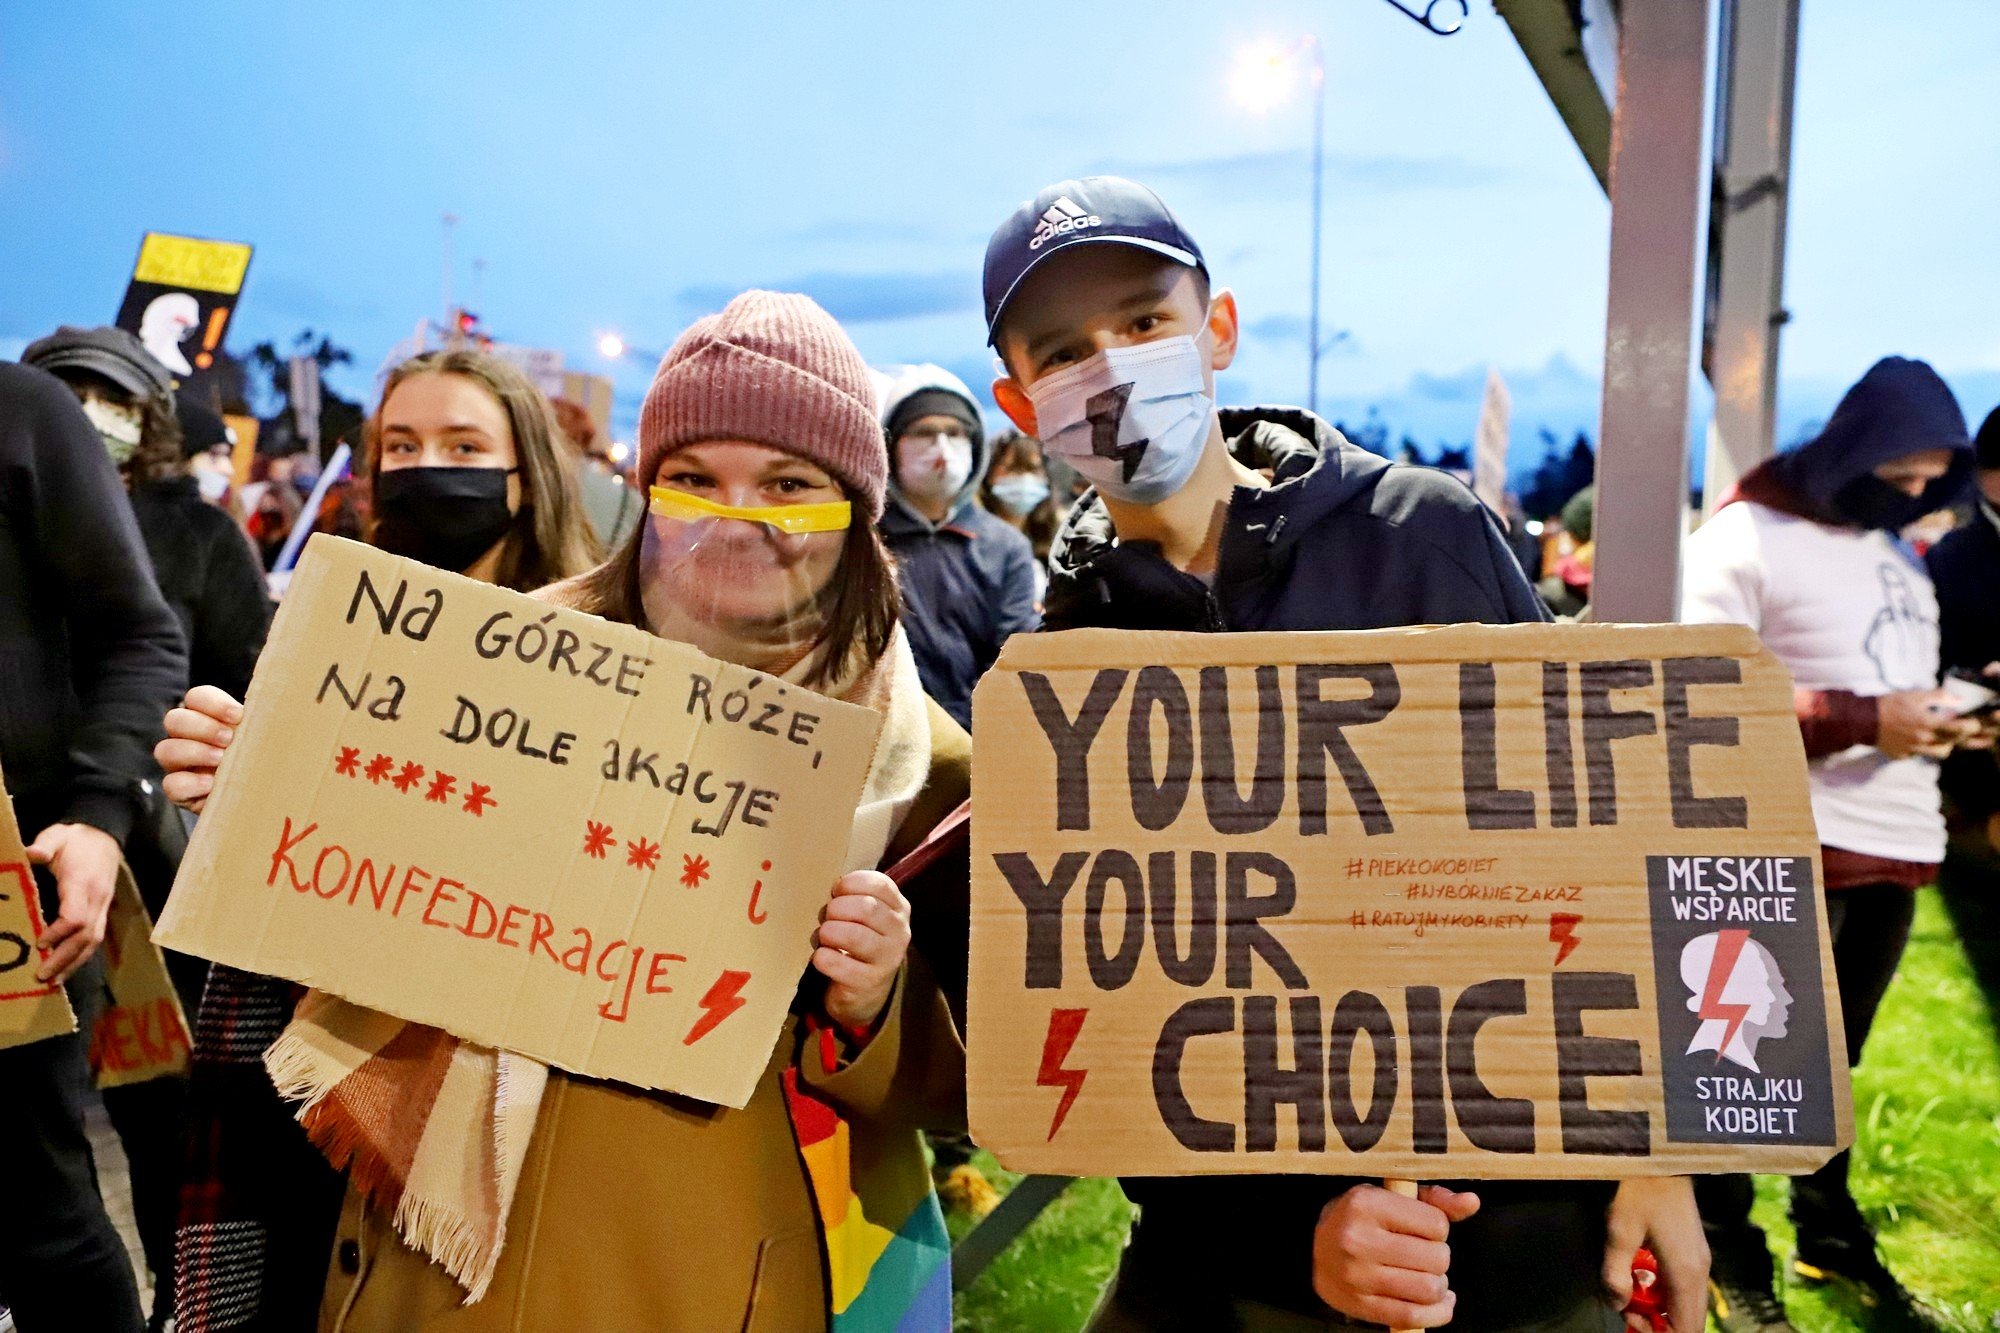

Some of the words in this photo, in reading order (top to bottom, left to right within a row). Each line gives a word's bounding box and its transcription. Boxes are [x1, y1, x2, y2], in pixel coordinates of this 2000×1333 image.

[1029, 214, 1102, 250] adidas
[475, 611, 655, 697] GÓRZE
[440, 694, 577, 766] DOLE
[1017, 661, 1401, 837] YOUR
[1457, 655, 1749, 832] LIFE
[747, 859, 774, 925] i
[1666, 856, 1798, 897] MĘSKIE
[1670, 895, 1798, 923] WSPARCIE
[990, 848, 1310, 992] YOUR
[1151, 970, 1652, 1157] CHOICE
[1695, 1076, 1804, 1102] STRAJKU
[1704, 1105, 1799, 1135] KOBIET
